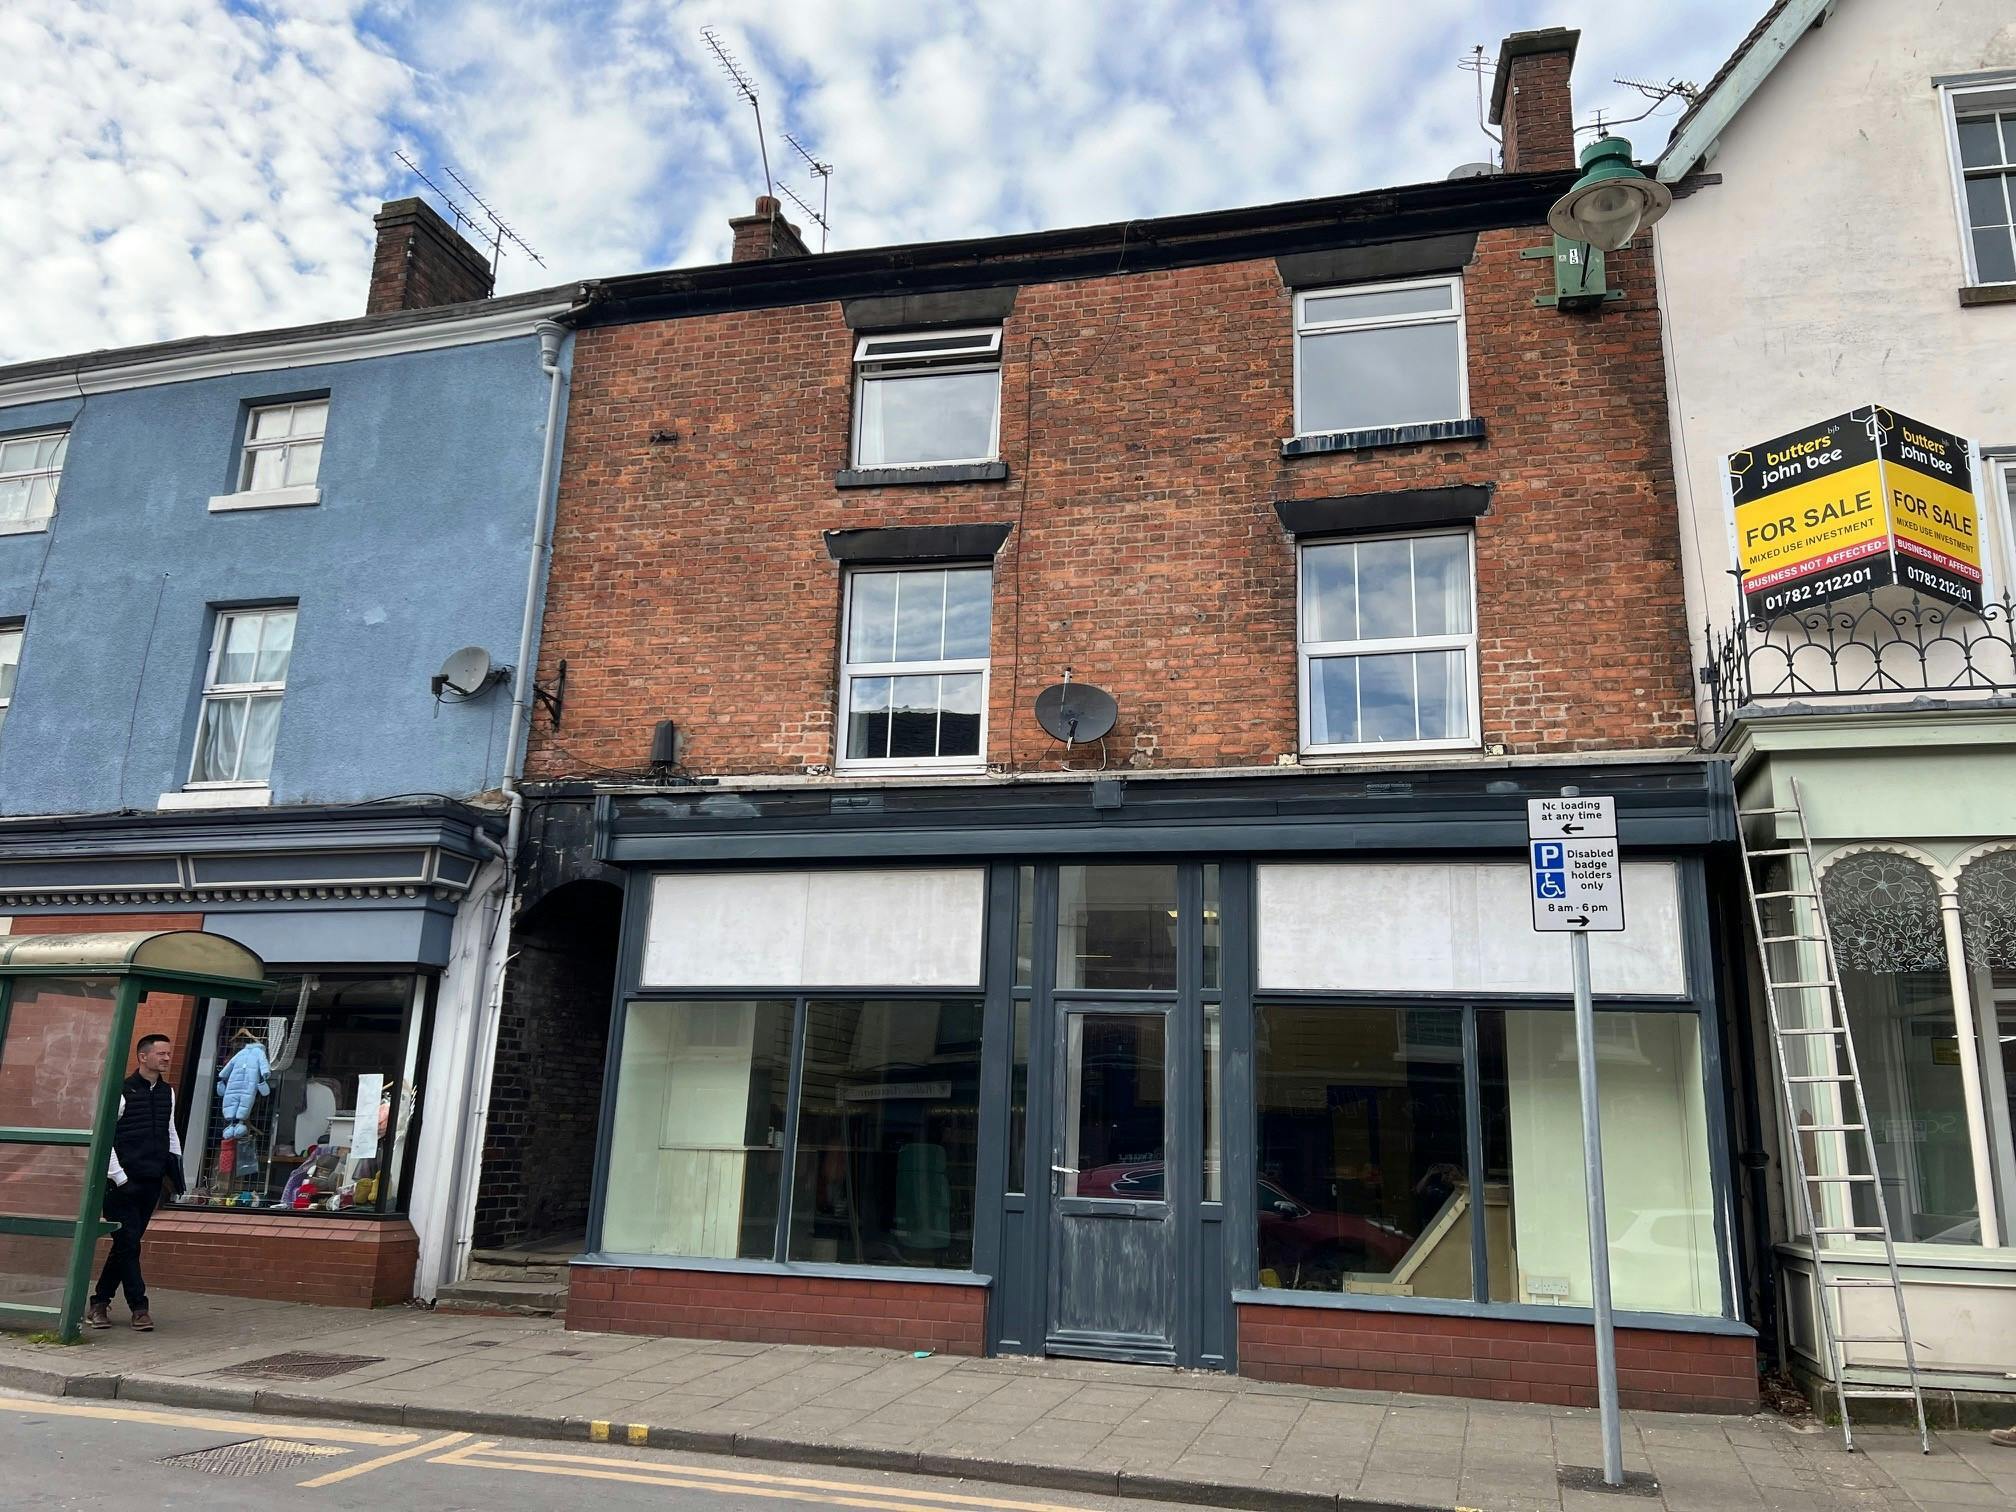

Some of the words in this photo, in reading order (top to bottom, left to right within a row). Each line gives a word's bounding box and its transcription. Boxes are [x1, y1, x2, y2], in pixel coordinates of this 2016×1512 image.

[1766, 435, 1832, 466] butters
[1902, 426, 1946, 456] butters
[1761, 462, 1802, 490] john
[1806, 448, 1842, 469] bee
[1900, 441, 1928, 465] john
[1929, 453, 1953, 475] bee
[1746, 516, 1797, 547] FOR
[1804, 490, 1873, 528] SALE
[1893, 489, 1928, 519] FOR
[1932, 504, 1973, 537] SALE
[1749, 548, 1781, 565] MIXED
[1782, 540, 1804, 554] USE
[1805, 517, 1875, 546] INVESTMENT
[1896, 517, 1919, 532] MIXED
[1919, 526, 1934, 538] USE
[1934, 530, 1974, 554] INVESTMENT
[1800, 559, 1822, 573] NOT
[1933, 553, 1947, 565] NOT
[1765, 585, 1812, 610] 01782
[1814, 567, 1872, 596] 212201
[1907, 566, 1938, 589] 01782
[1938, 578, 1972, 602] 212201
[1541, 812, 1552, 820] at
[1556, 812, 1574, 821] any
[1578, 811, 1602, 819] time
[1561, 801, 1600, 810] loading
[1541, 845, 1559, 867] P
[1567, 849, 1614, 858] Disabled
[1574, 860, 1607, 869] badge
[1571, 871, 1612, 879] holders
[1580, 882, 1604, 890] only
